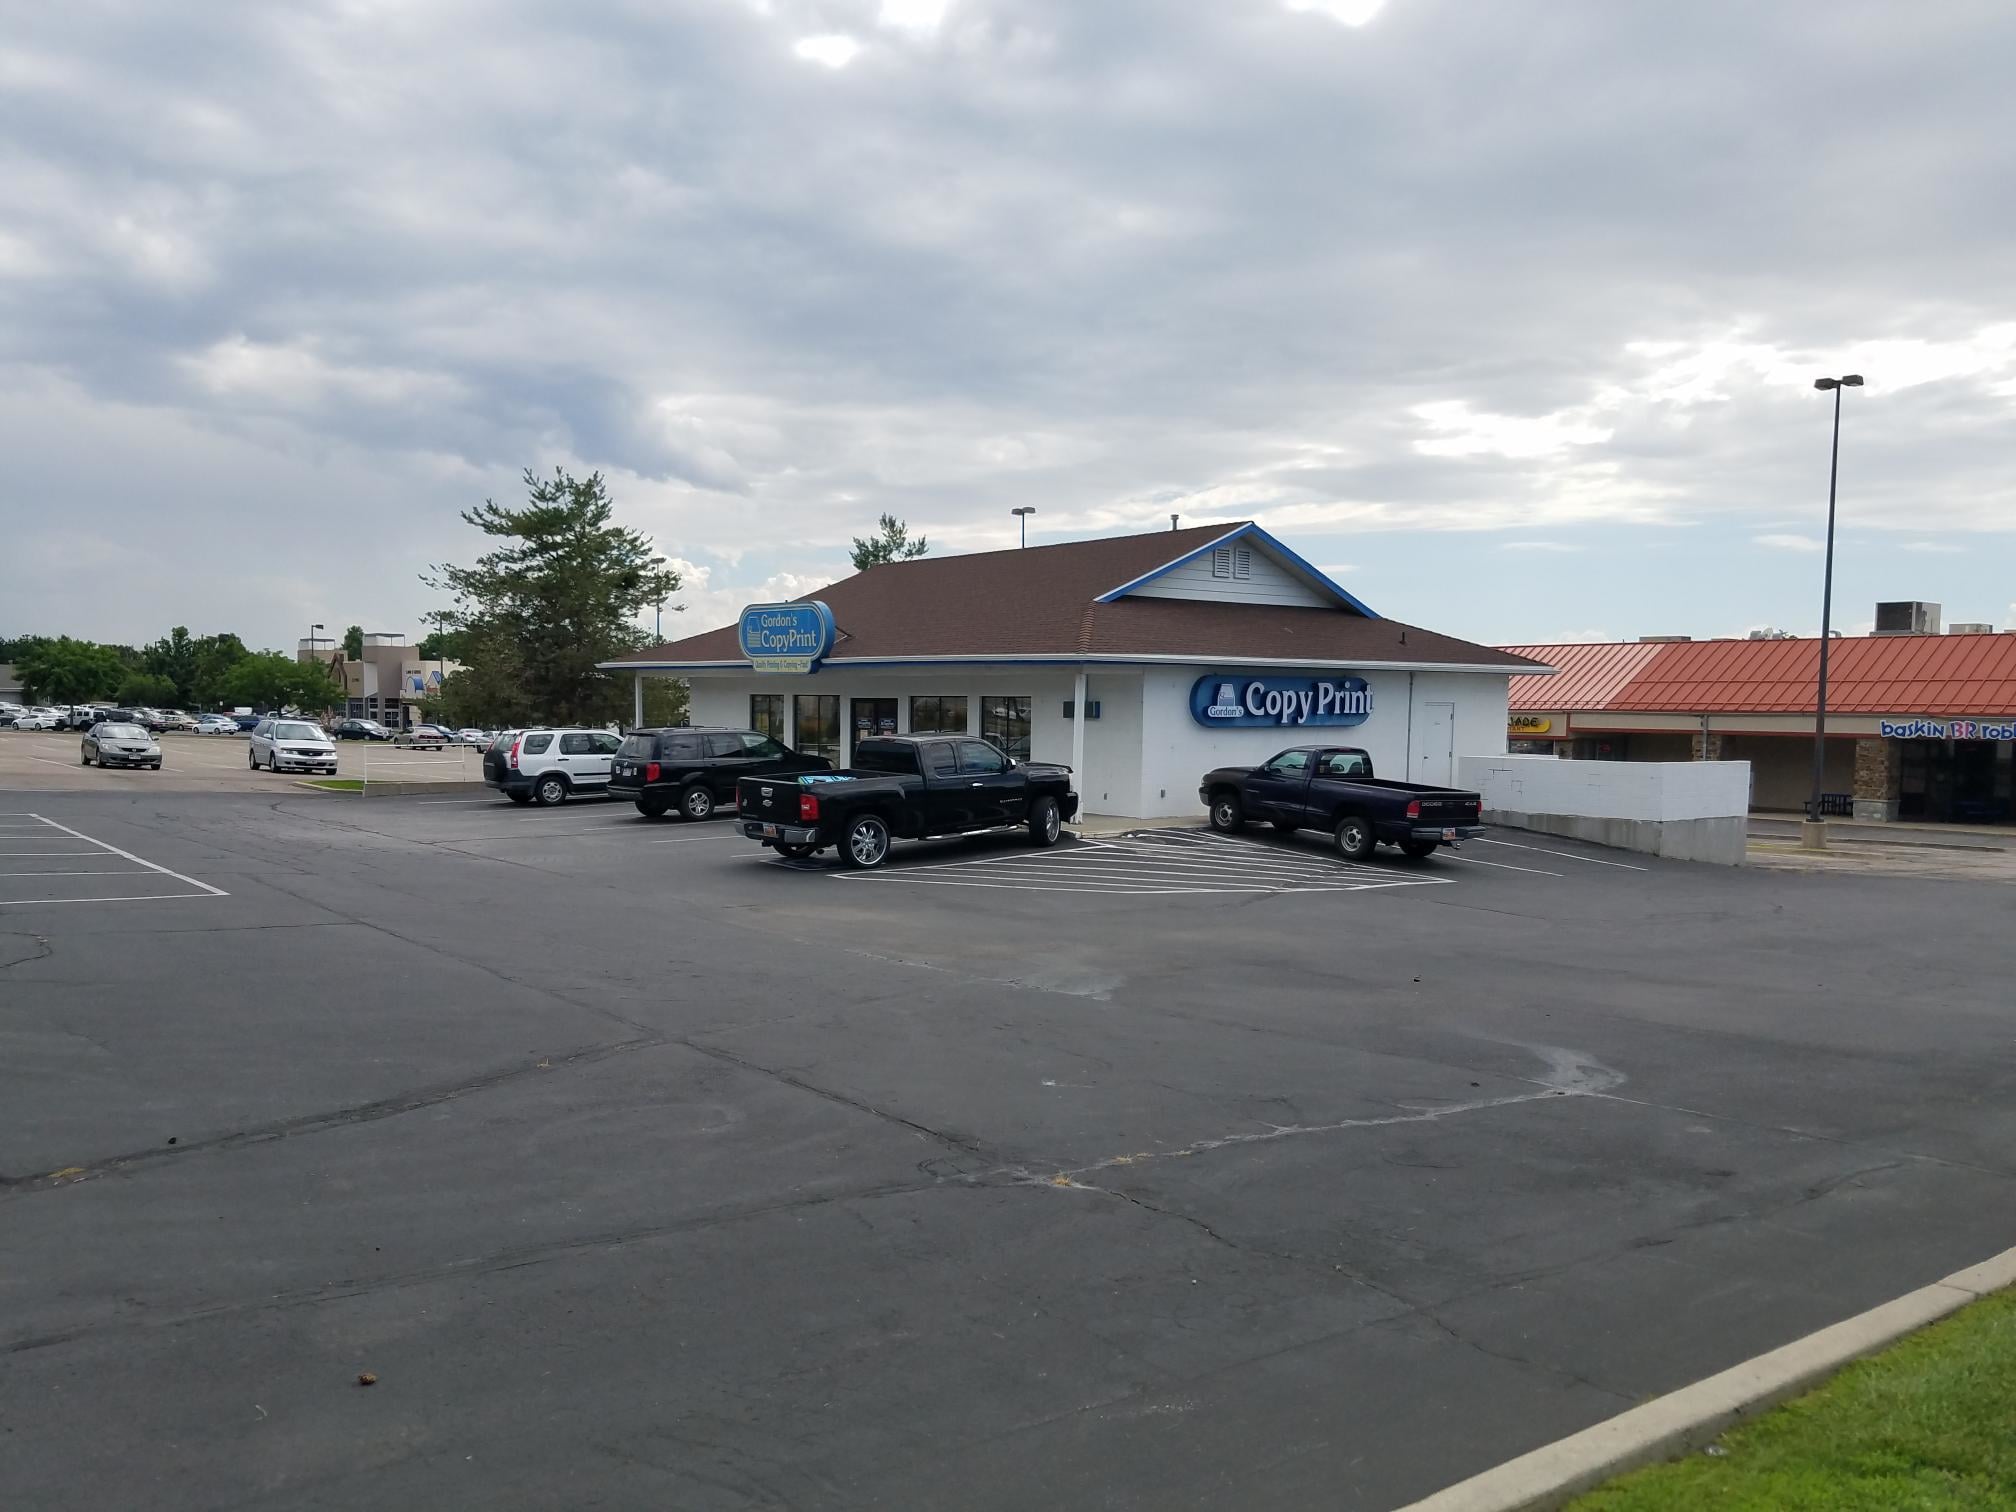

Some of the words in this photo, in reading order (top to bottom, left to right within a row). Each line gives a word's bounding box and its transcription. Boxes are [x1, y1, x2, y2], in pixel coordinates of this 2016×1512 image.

[761, 613, 798, 628] Gordon's
[761, 629, 817, 653] CopyPrint
[1209, 706, 1243, 716] Gordon's
[1246, 681, 1313, 724] Copy
[1317, 681, 1374, 715] Print
[1880, 719, 1946, 739] baskin
[1949, 721, 1977, 739] BR
[1981, 721, 2016, 741] rob
